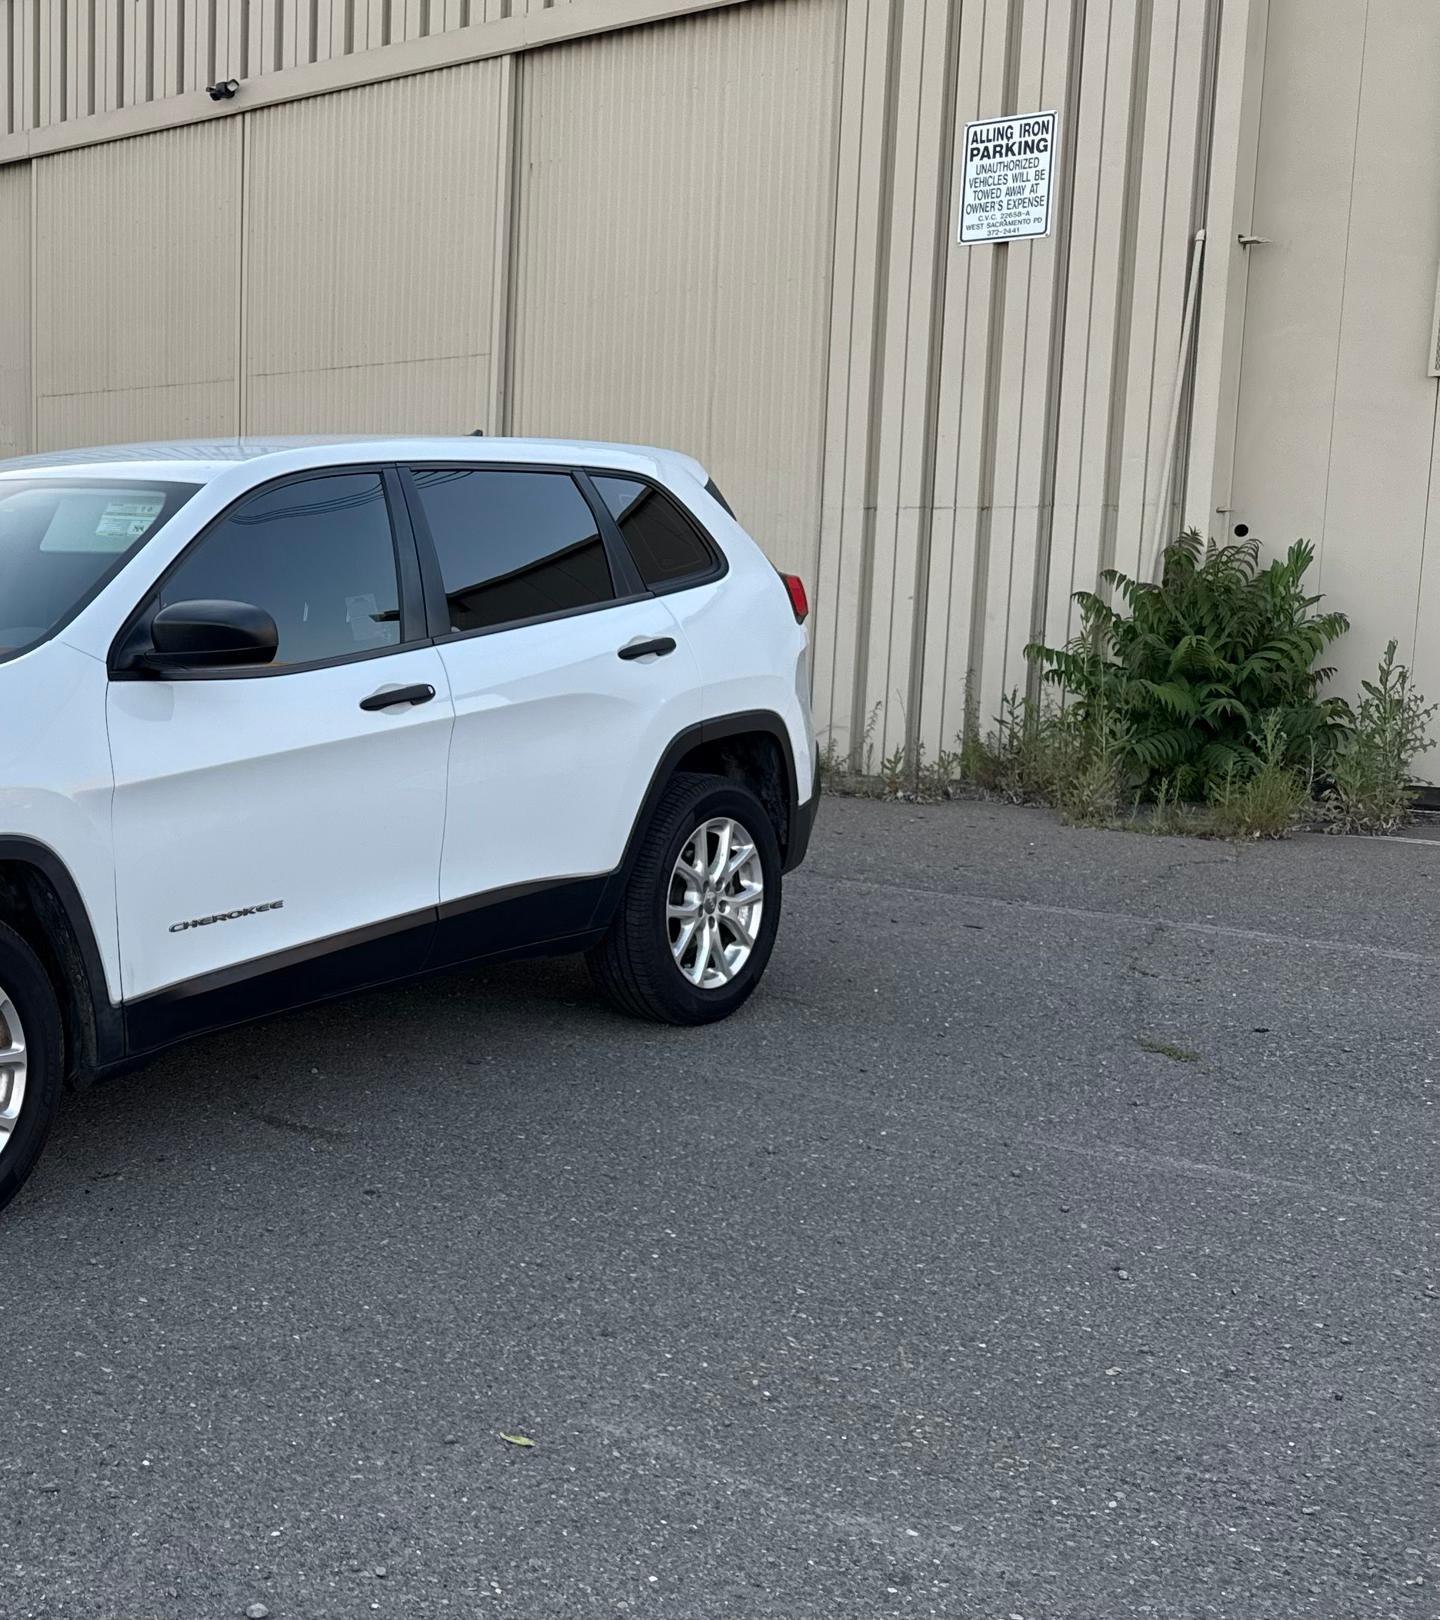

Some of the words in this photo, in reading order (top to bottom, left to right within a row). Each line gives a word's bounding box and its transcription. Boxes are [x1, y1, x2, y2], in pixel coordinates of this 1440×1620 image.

[971, 125, 1014, 145] ALLING
[1020, 119, 1050, 138] IRON
[970, 138, 1048, 162] PARKING
[976, 157, 1040, 175] UNAUTHORIZED
[969, 174, 1008, 188] VEHICLES
[1012, 172, 1030, 183] WILL
[1034, 169, 1046, 181] BE
[973, 188, 1001, 201] TOWED
[1005, 185, 1026, 198] AWAY
[1029, 183, 1040, 194] AT
[966, 201, 1003, 215] OWNER'S
[1006, 196, 1045, 210] EXPENSE
[966, 223, 984, 231] WEST
[987, 219, 1031, 229] SACRAMENTO
[169, 900, 284, 933] CHEROKEE
